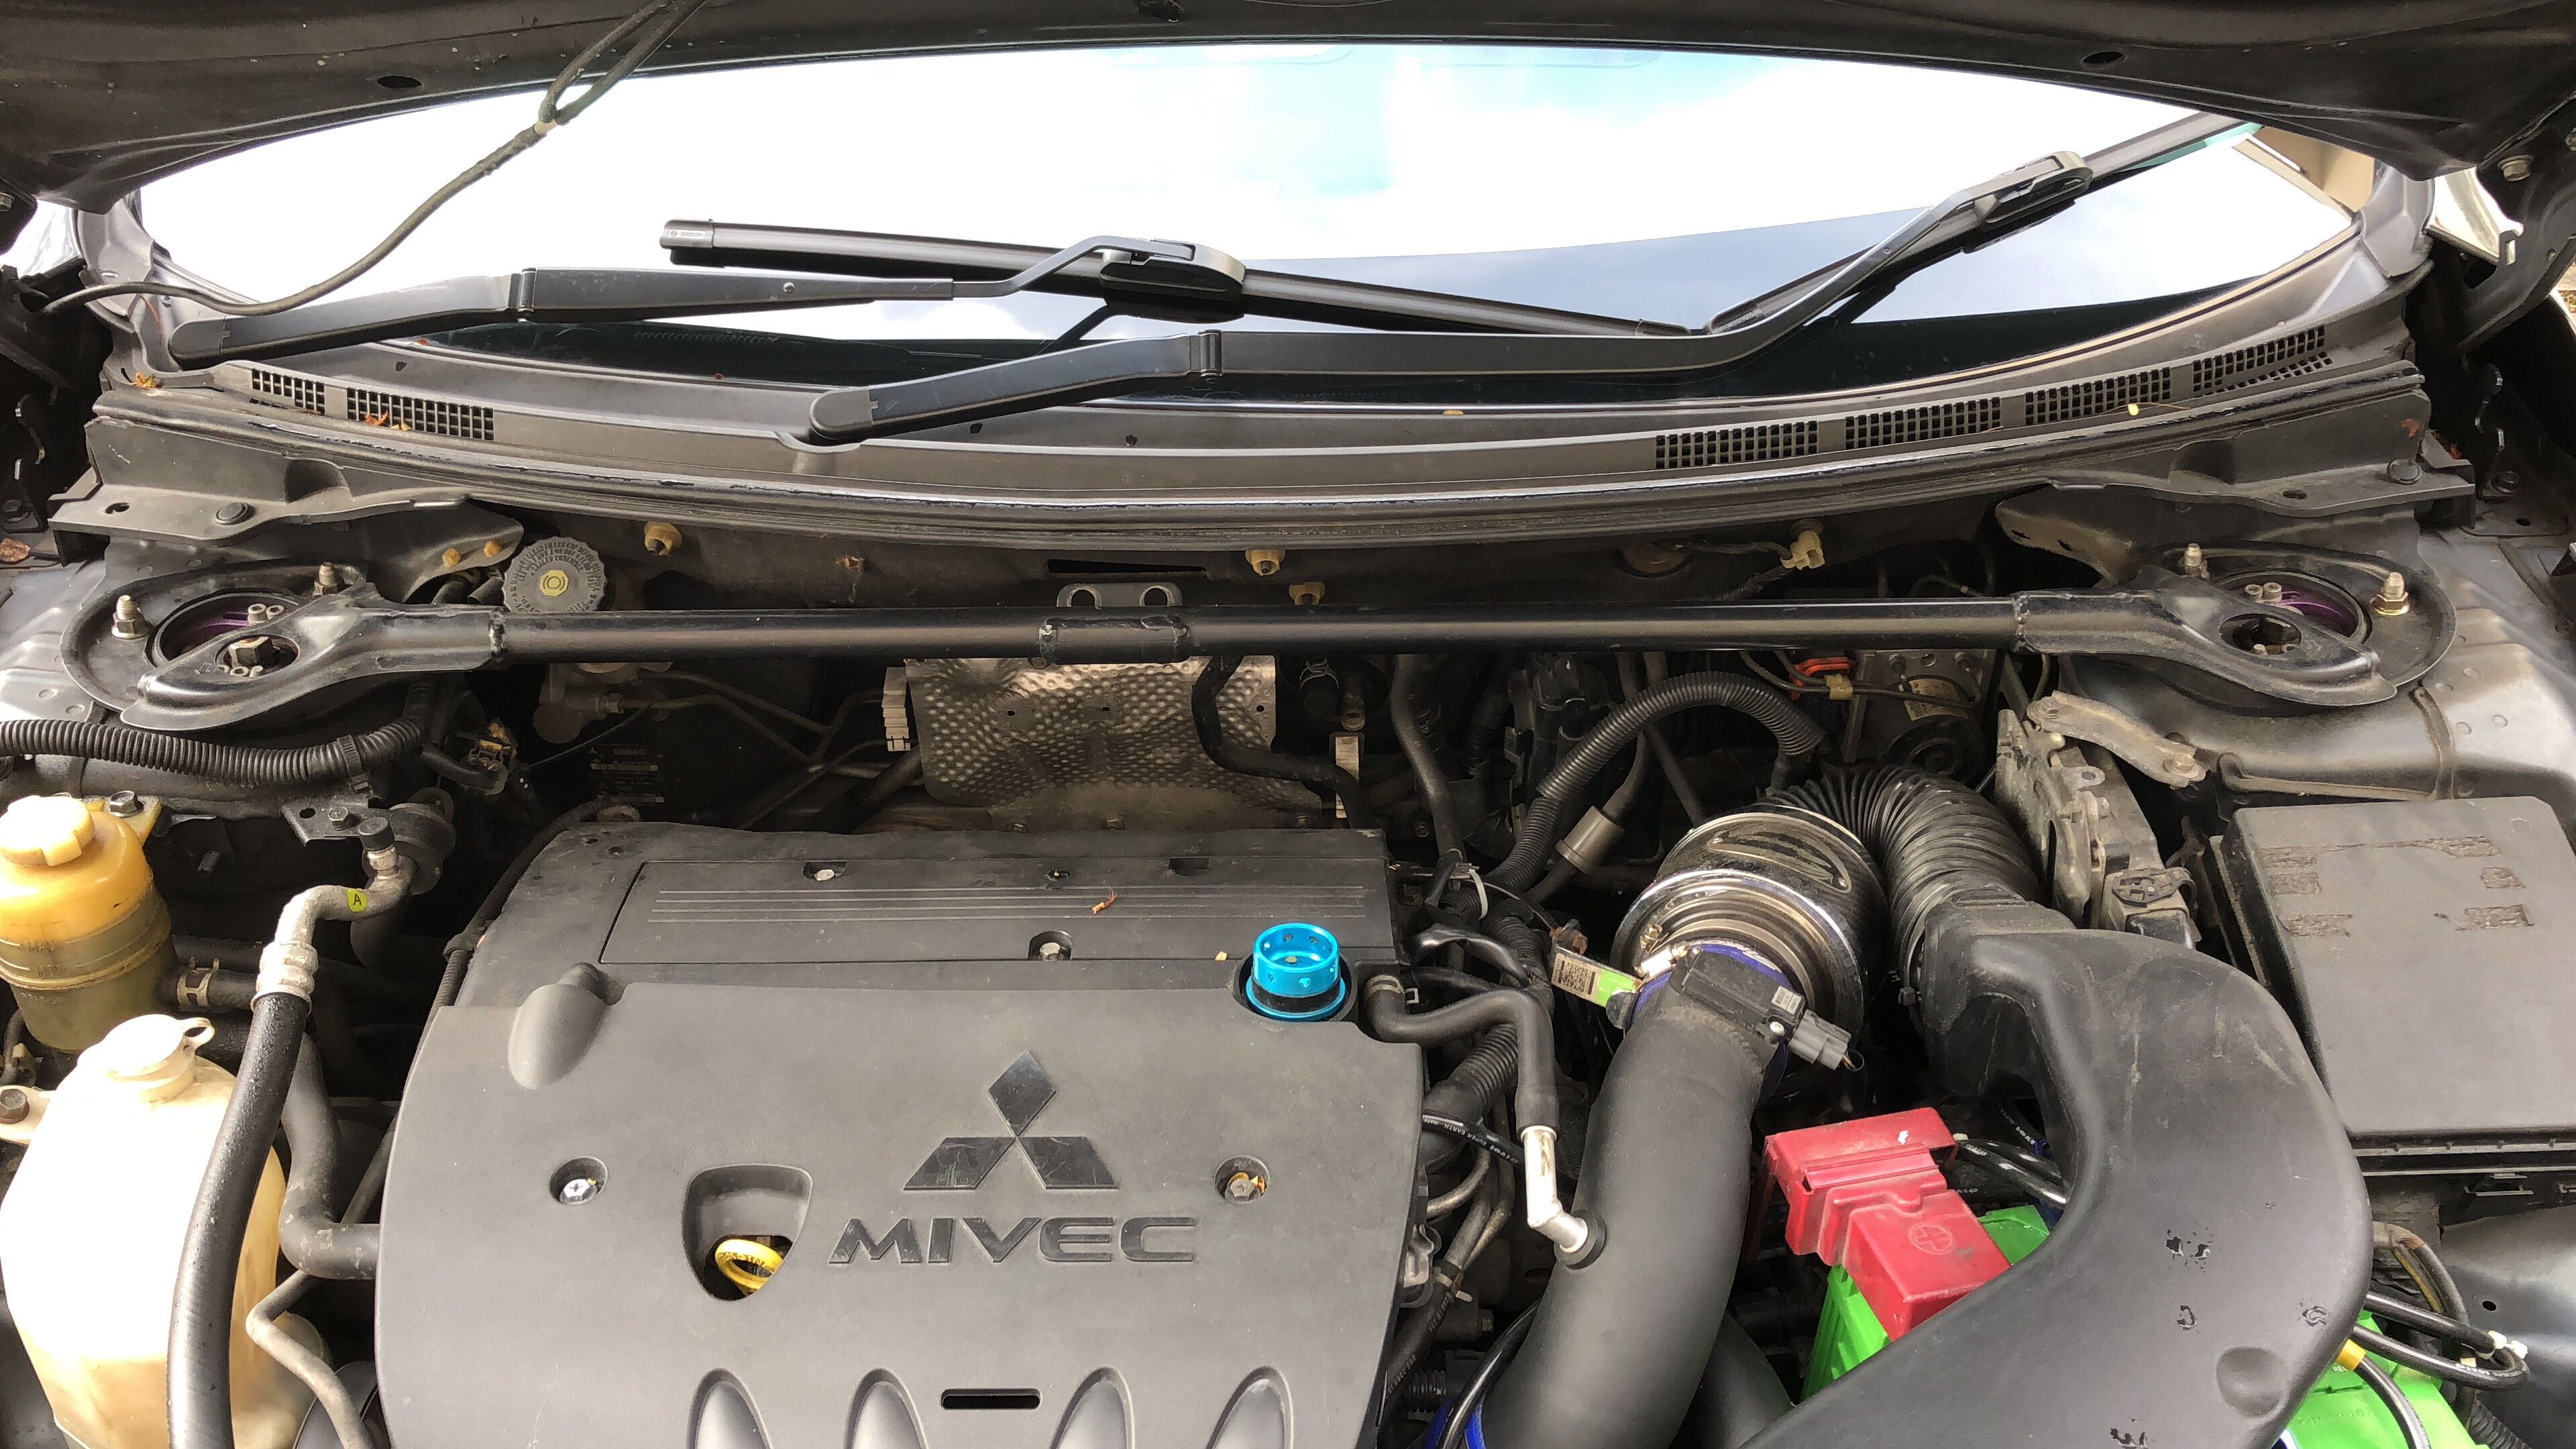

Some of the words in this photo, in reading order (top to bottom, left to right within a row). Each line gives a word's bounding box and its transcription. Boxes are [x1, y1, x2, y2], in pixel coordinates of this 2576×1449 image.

[353, 893, 362, 906] A
[1444, 1123, 1466, 1136] EARTH
[1466, 1132, 1487, 1146] SUPER
[829, 1217, 1196, 1264] MIVEC
